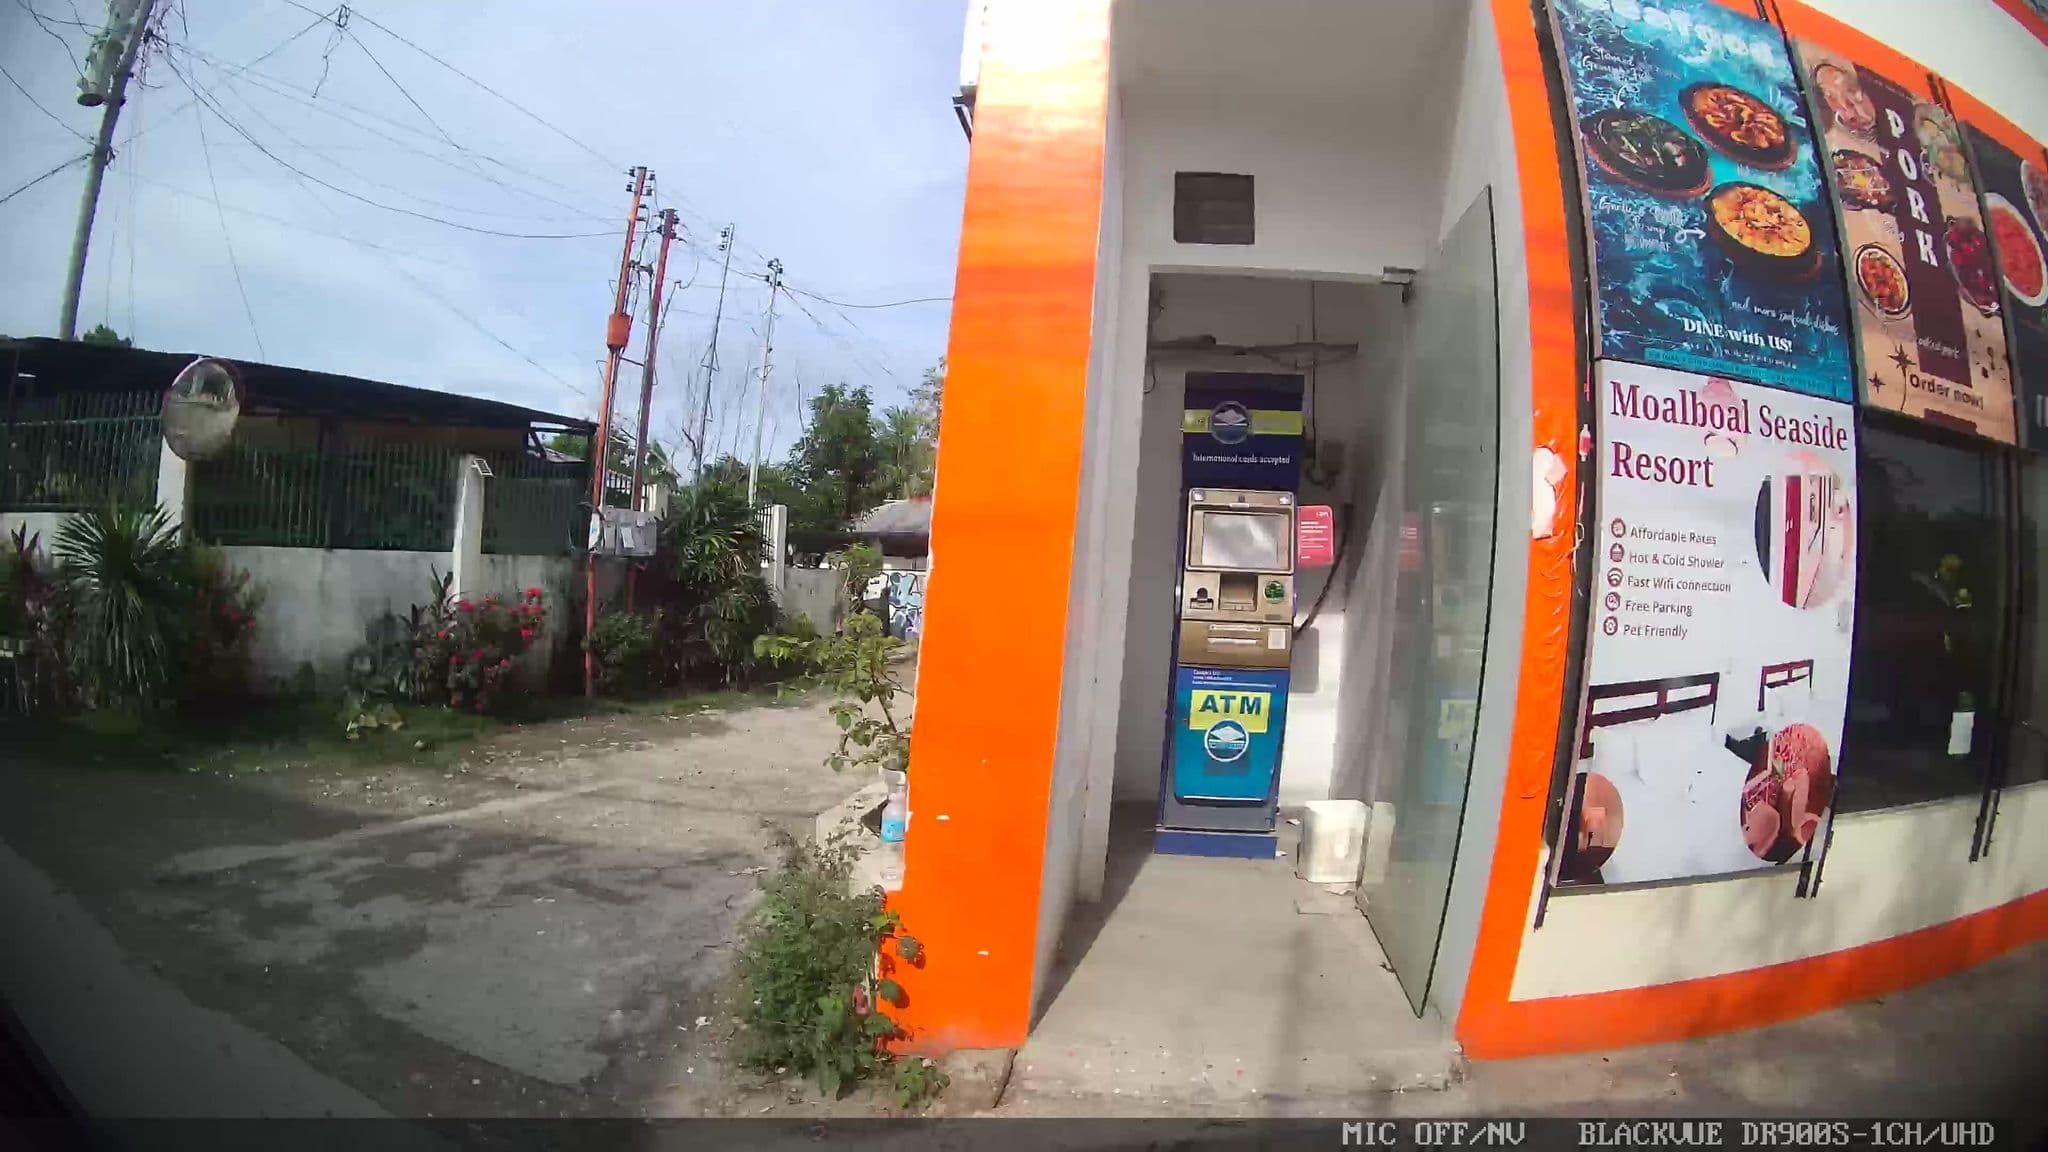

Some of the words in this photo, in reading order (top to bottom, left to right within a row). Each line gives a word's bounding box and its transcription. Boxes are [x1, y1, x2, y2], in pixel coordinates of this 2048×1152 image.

[1682, 317, 1725, 338] DINE
[1726, 329, 1766, 347] with
[1768, 335, 1794, 353] US!
[1909, 373, 1950, 398] Order
[1953, 389, 1985, 410] now!
[1609, 380, 1752, 435] Moalboal
[1758, 404, 1849, 451] Seaside
[1193, 452, 1238, 463] International
[1239, 453, 1258, 464] cards
[1259, 454, 1291, 466] accepted
[1610, 441, 1714, 488] Resort
[1630, 526, 1687, 543] Affordable
[1688, 531, 1717, 545] Rates
[1629, 551, 1649, 564] Hot
[1651, 553, 1660, 565] &
[1662, 554, 1686, 567] Cold
[1687, 556, 1725, 569] Shower
[1627, 575, 1651, 588] Fast
[1652, 577, 1674, 590] Wifi
[1675, 579, 1732, 593] connection
[1625, 599, 1650, 612] Free
[1652, 600, 1694, 618] Parking
[1623, 624, 1643, 637] Pet
[1644, 624, 1688, 641] Friendly
[1198, 694, 1262, 716] ATM
